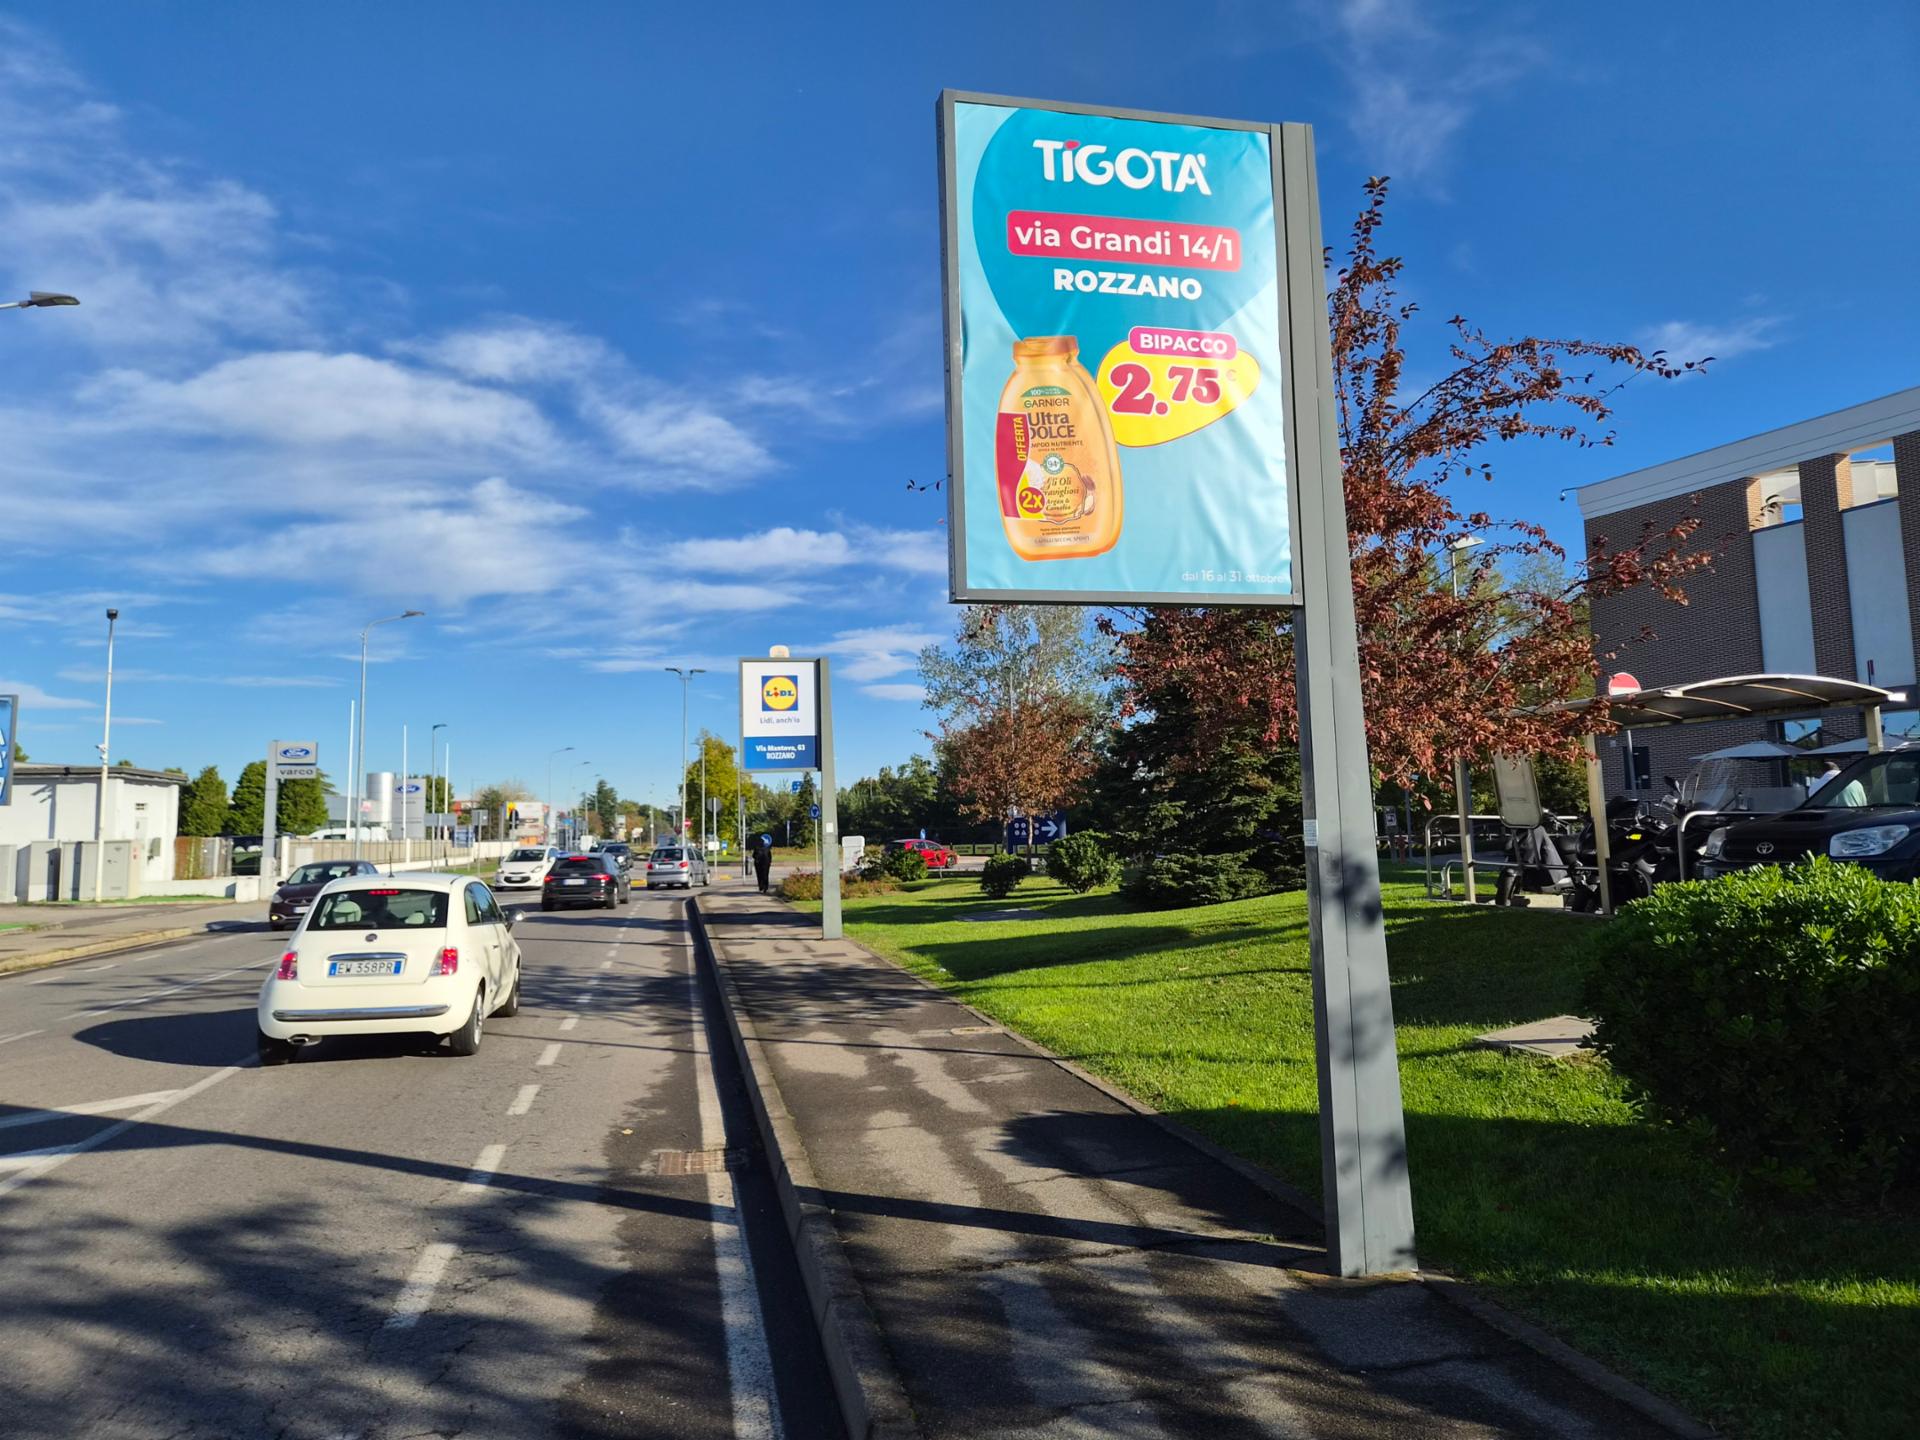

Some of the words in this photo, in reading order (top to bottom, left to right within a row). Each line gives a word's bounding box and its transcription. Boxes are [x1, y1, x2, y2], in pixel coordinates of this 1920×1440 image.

[1014, 220, 1061, 247] via
[1070, 225, 1171, 257] Grandi
[1179, 233, 1234, 262] 14/1
[1053, 268, 1203, 300] ROZZANO
[1139, 333, 1228, 355] BIPACCO
[1023, 397, 1070, 409] GARNIER
[1109, 362, 1221, 416] 2.75
[1027, 411, 1070, 427] Ultra
[1013, 416, 1028, 462] OFFERTA
